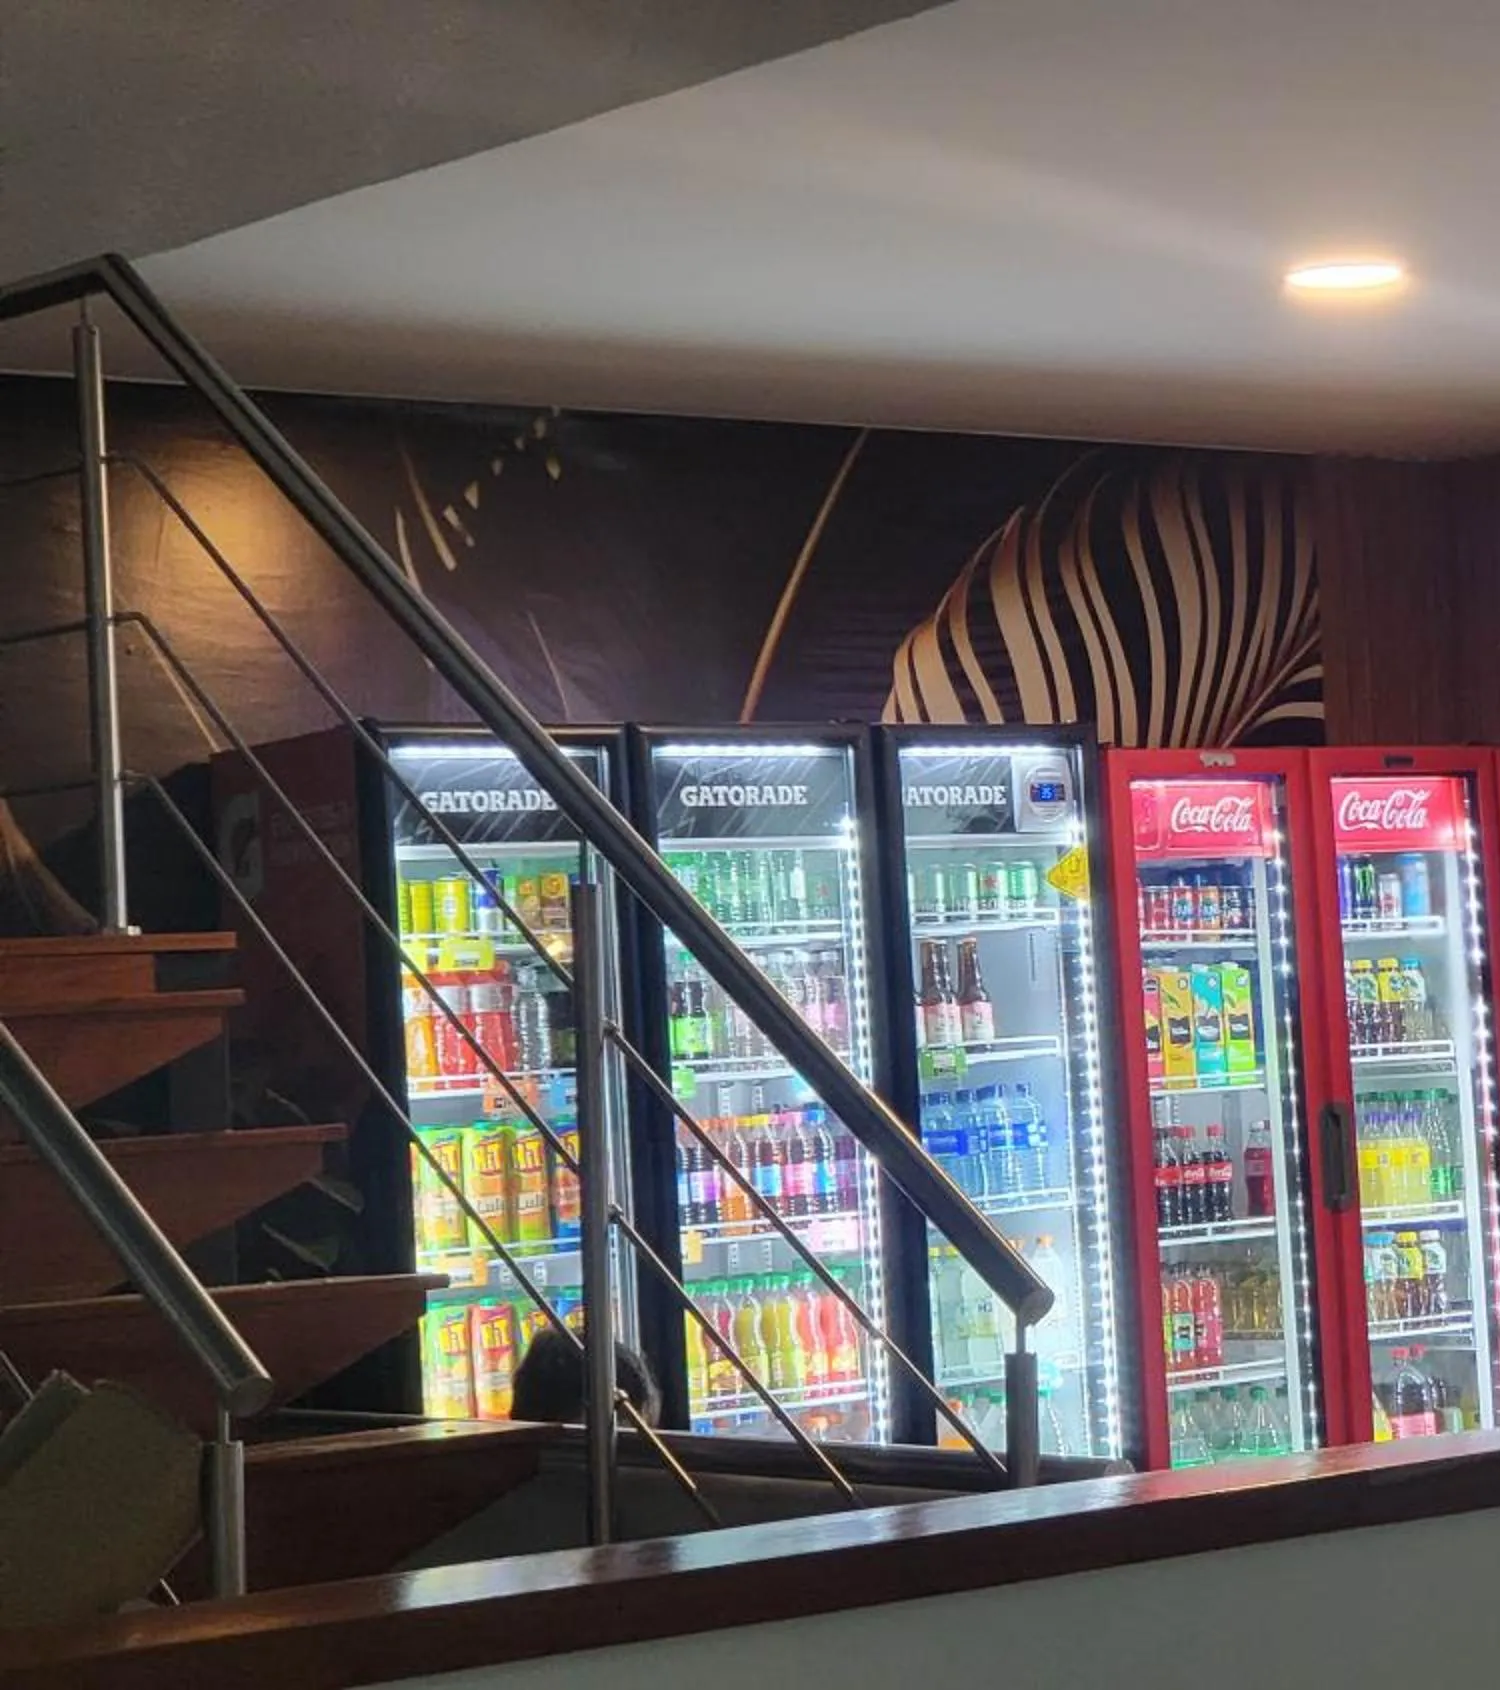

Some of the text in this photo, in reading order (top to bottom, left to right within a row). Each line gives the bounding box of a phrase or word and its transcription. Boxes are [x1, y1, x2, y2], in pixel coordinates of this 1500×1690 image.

[679, 785, 809, 807] GATORADE
[904, 784, 1008, 806] ATORADE
[1338, 789, 1431, 832] Coca-Cola
